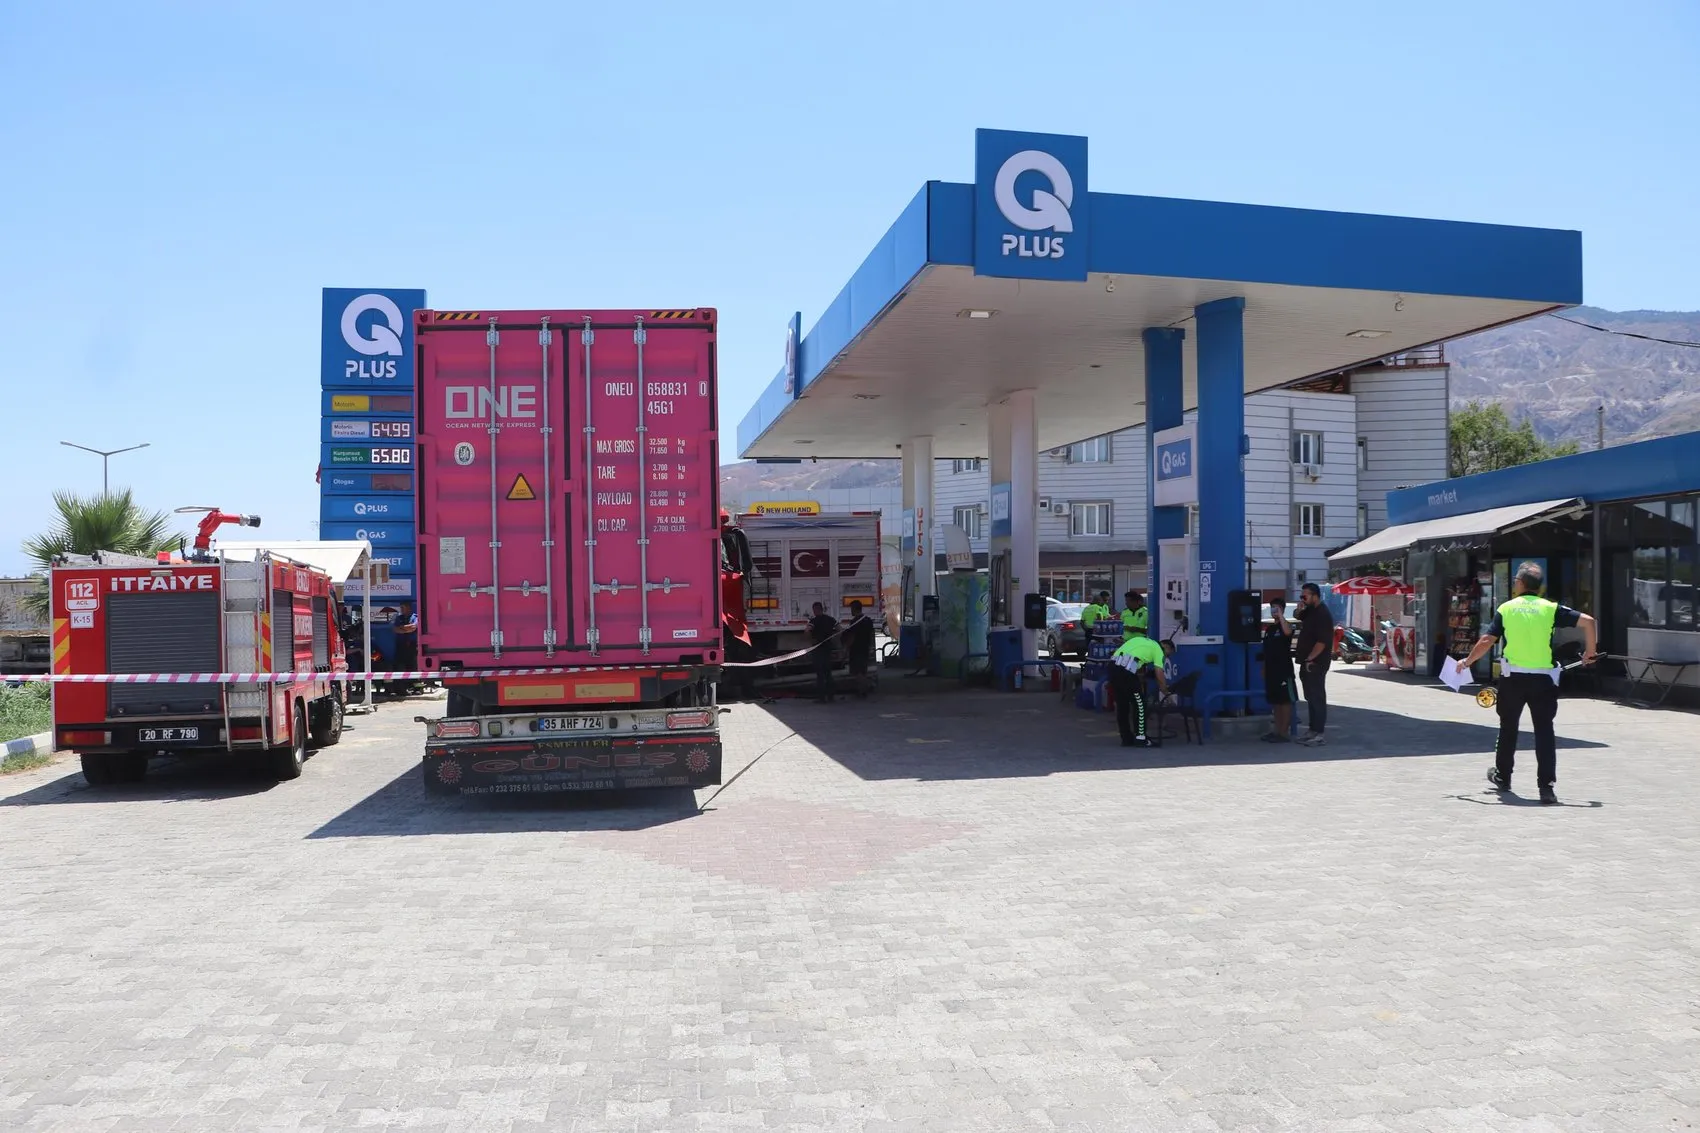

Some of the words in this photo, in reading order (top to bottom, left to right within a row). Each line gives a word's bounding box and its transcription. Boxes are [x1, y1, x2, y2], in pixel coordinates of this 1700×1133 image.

[994, 150, 1073, 232] Q
[1001, 233, 1065, 259] PLUS
[340, 293, 404, 356] Q
[345, 360, 397, 378] PLUS
[605, 382, 634, 396] ONEU
[647, 382, 688, 396] 658831
[445, 385, 536, 419] ONE
[647, 400, 674, 415] 45G1
[372, 422, 410, 437] 64.99
[596, 440, 613, 454] MAX
[614, 439, 635, 454] GROSS
[677, 437, 686, 447] kg
[371, 448, 410, 463] 65.80
[1172, 452, 1186, 467] GAS
[597, 465, 616, 480] TARE
[677, 463, 686, 473] kg
[597, 492, 632, 506] PAYLOAD
[1427, 488, 1458, 506] market
[367, 505, 388, 513] PLUS
[781, 506, 812, 514] HOLLAND
[597, 518, 610, 532] CU.
[611, 518, 628, 532] CAP.
[916, 507, 924, 557] UTTS
[369, 531, 386, 539] GAS
[70, 583, 94, 598] 112
[73, 615, 91, 624] K-15
[544, 718, 557, 730] 35
[560, 718, 580, 729] AHF
[582, 717, 602, 729] 724
[145, 730, 156, 740] 20
[162, 729, 174, 739] RF
[180, 729, 197, 739] 790
[470, 751, 677, 774] GÜNEŞ
